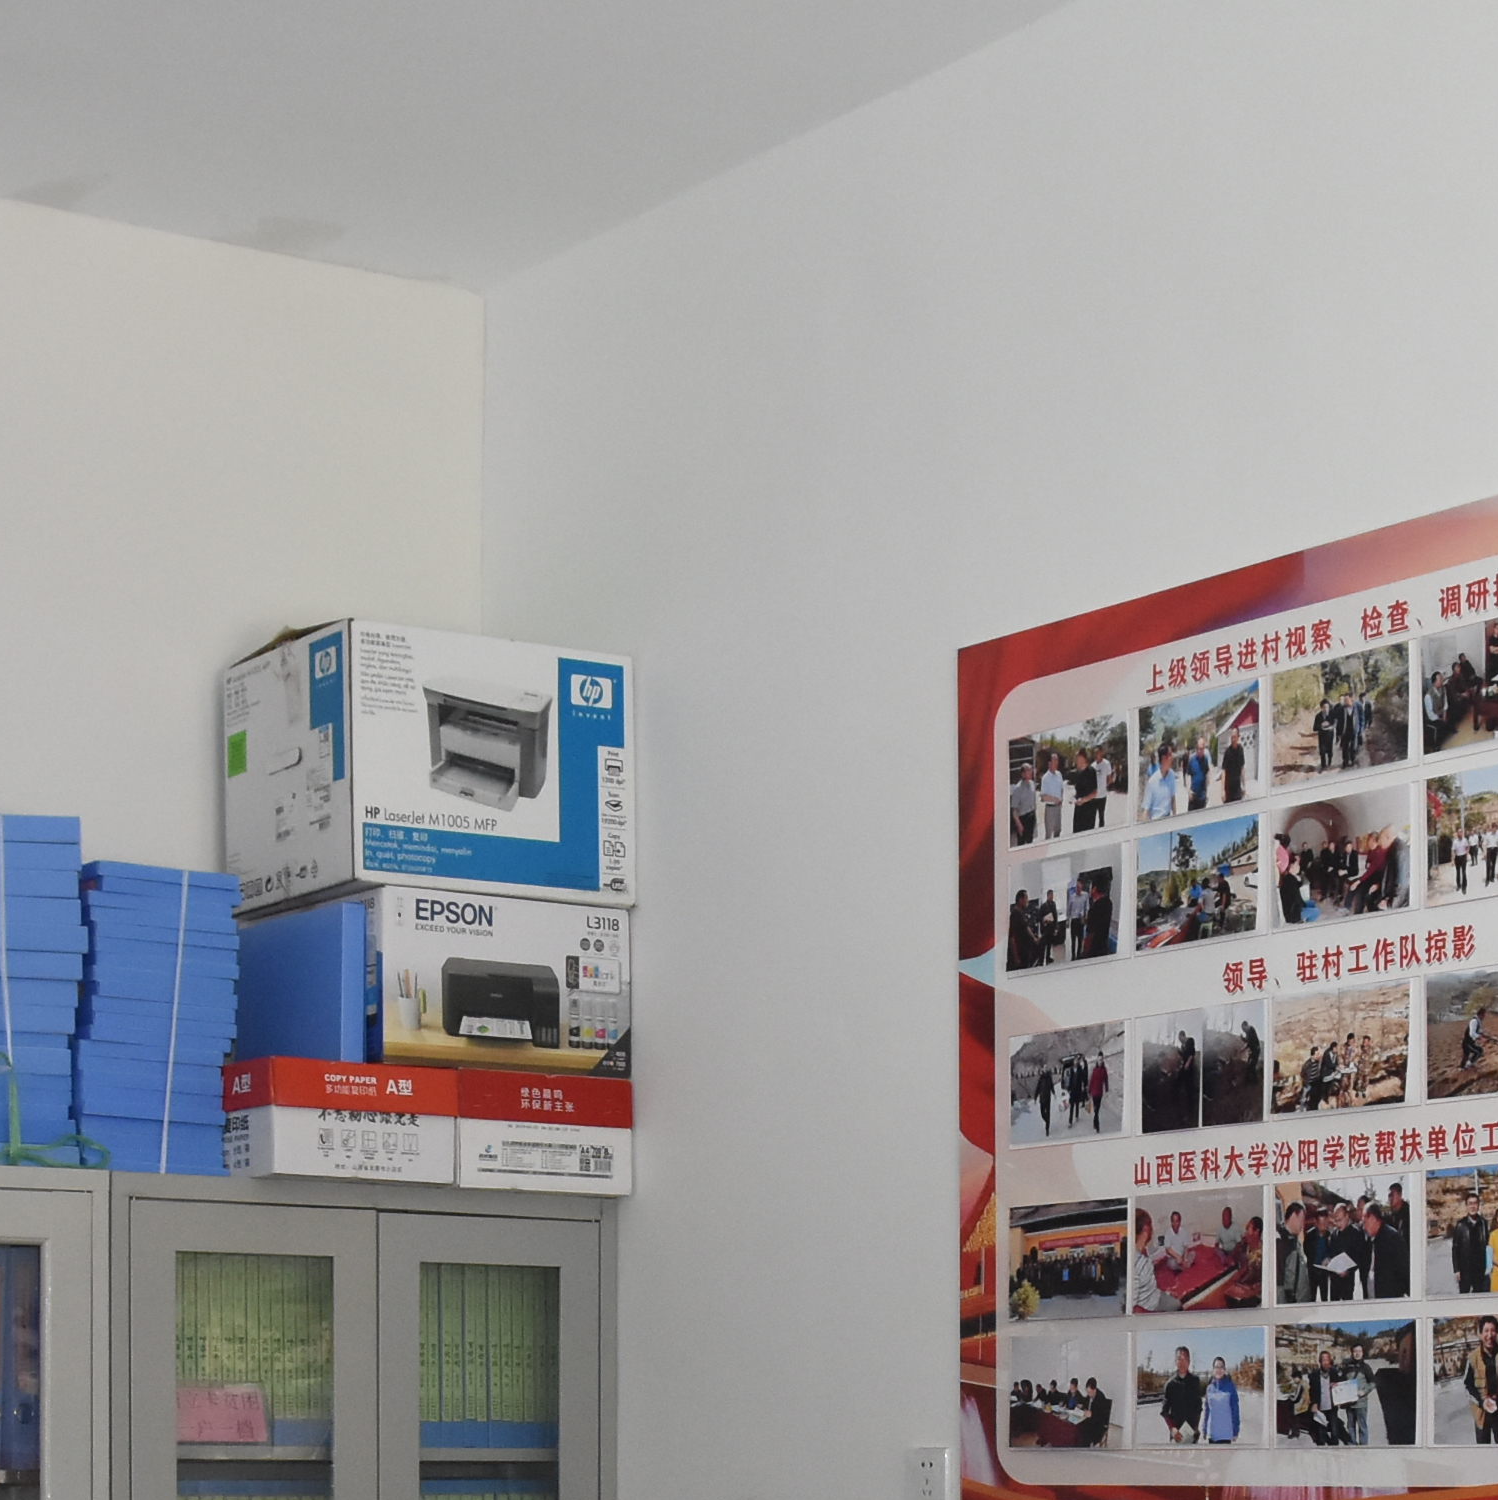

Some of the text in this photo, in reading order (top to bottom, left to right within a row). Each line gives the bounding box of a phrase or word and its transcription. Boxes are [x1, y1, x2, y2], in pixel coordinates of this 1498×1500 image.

[365, 805, 498, 831] HP LaserJet M1005 MFP
[415, 898, 494, 927] EPSON
[415, 923, 494, 938] EXCEED YOUR VISION
[586, 916, 620, 932] L3118
[1223, 924, 1476, 993] 领导、驻村工作队掠影
[232, 1073, 251, 1095] A型
[324, 1073, 377, 1085] COPY PAPER
[326, 1084, 377, 1097] 多功能复印纸
[386, 1079, 413, 1096] A型
[521, 1099, 575, 1112] 环保新主张
